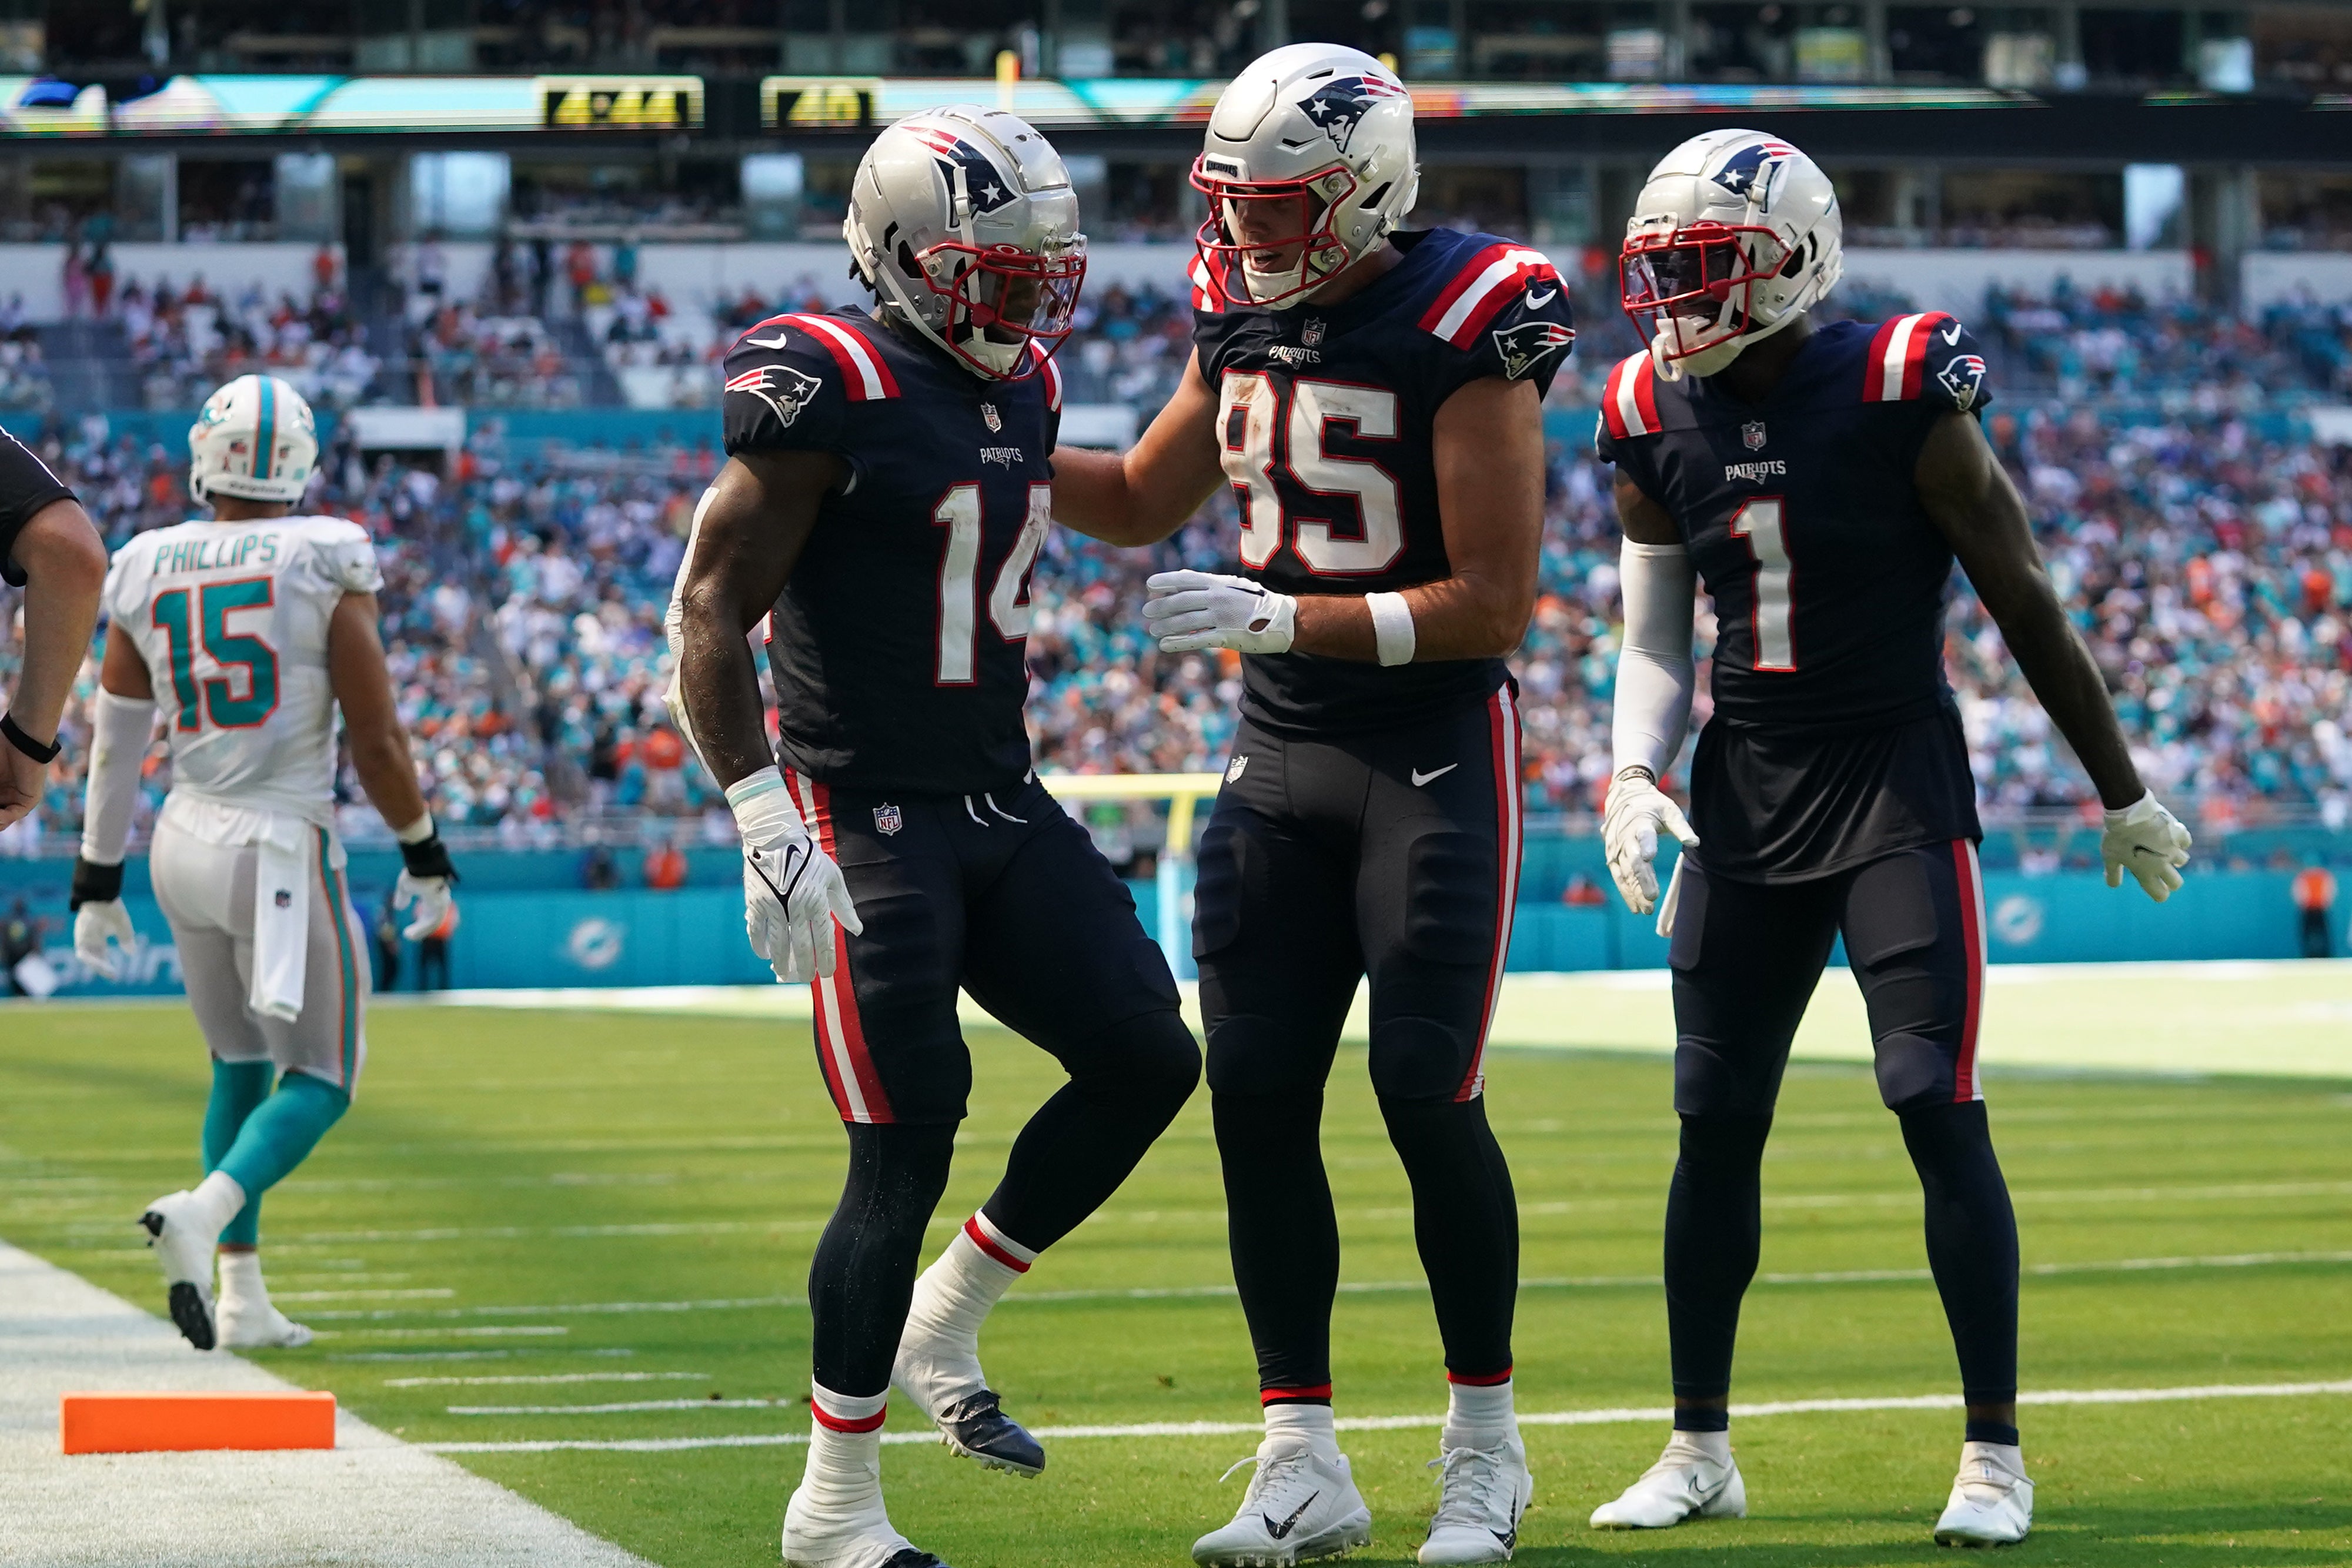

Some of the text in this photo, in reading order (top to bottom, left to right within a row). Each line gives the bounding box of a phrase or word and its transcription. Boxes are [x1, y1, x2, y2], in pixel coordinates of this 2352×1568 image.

[1268, 346, 1321, 363] PATRIOTS
[980, 447, 1024, 464] PATRIOTS
[1215, 367, 1407, 577] 85
[1724, 460, 1786, 482] PATRIOTS
[153, 533, 279, 575] PHILLIPS
[931, 480, 1051, 687] 14
[1730, 495, 1797, 672] 1
[152, 576, 279, 732] 15
[880, 817, 898, 829] NFL
